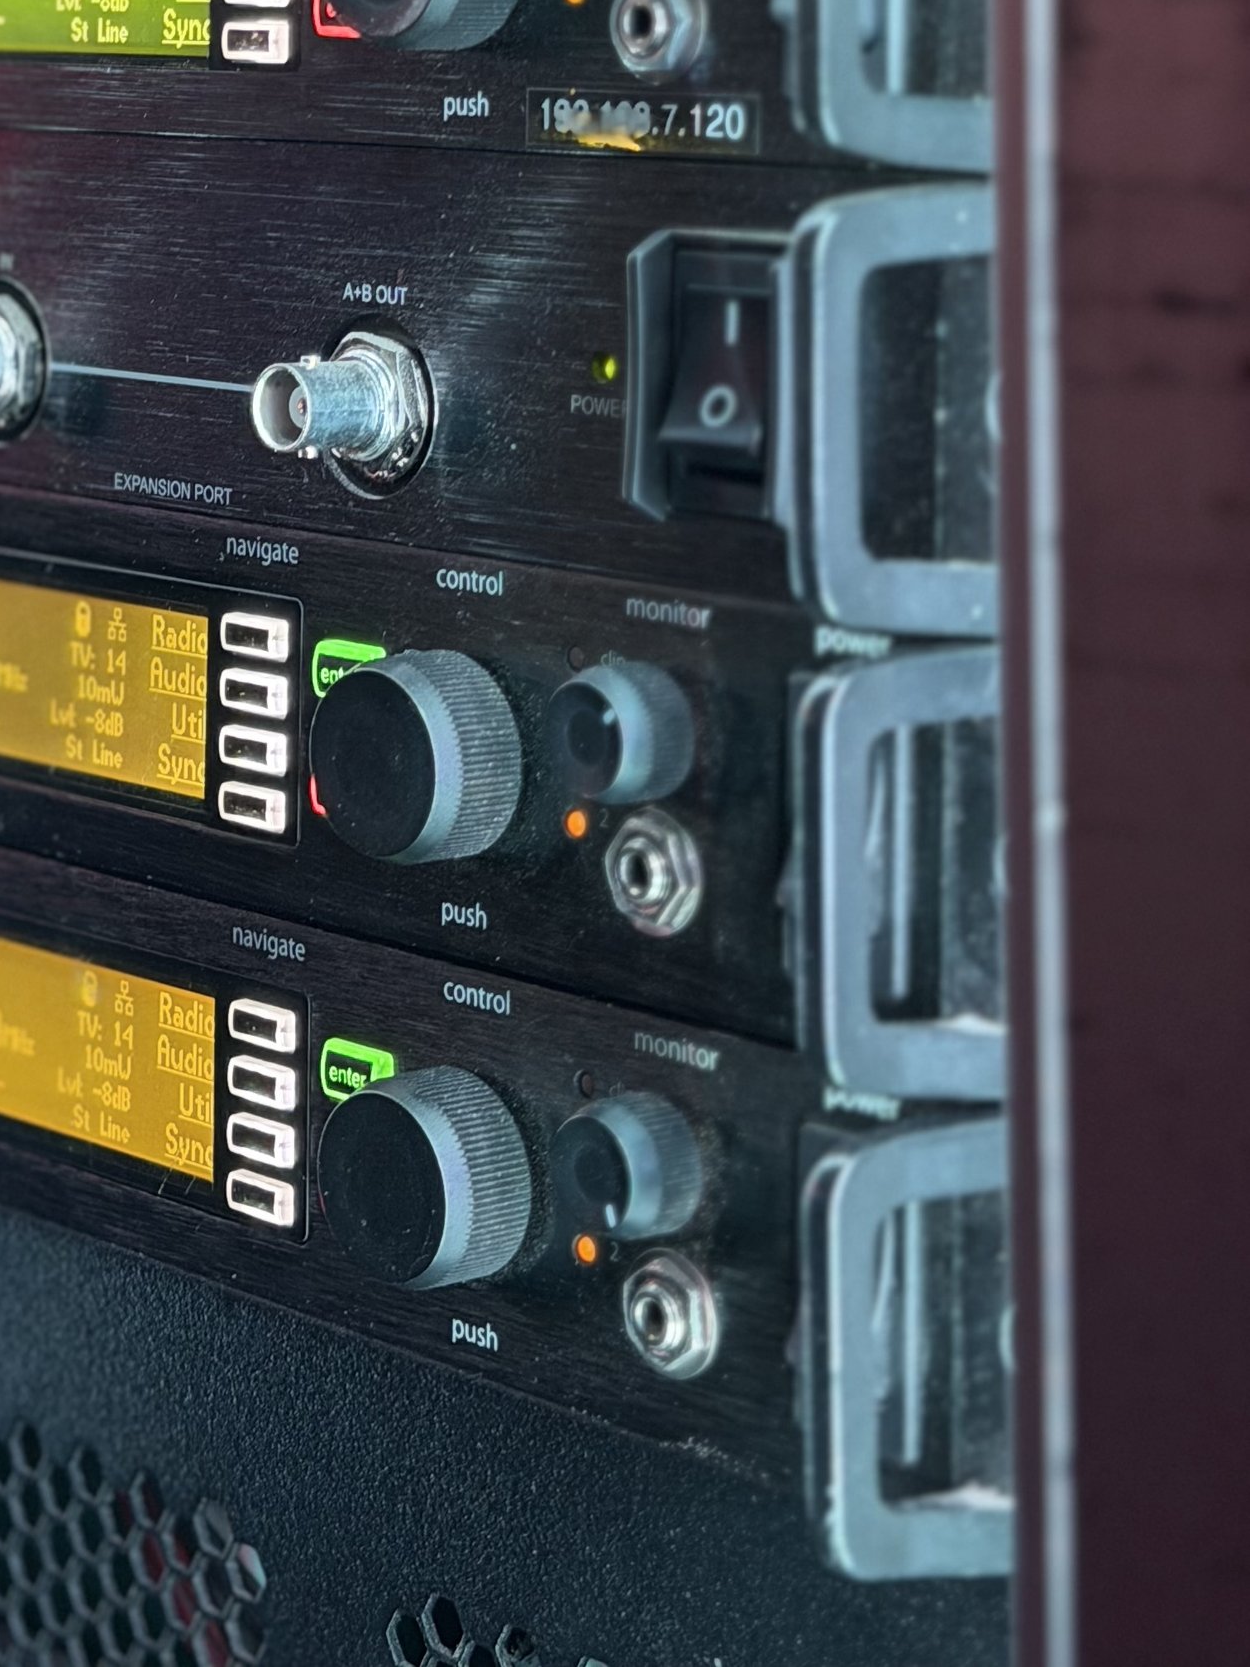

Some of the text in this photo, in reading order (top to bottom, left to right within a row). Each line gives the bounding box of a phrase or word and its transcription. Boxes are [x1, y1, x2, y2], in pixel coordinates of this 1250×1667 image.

[71, 17, 128, 43] St Line
[443, 90, 489, 121] push
[342, 282, 408, 305] A+B OUT
[114, 472, 233, 506] EXPANSION PORT
[226, 534, 300, 565] navigate
[436, 566, 504, 597] control
[626, 595, 711, 629] monitor
[152, 614, 207, 654] Radio
[70, 642, 126, 675] TV: 14
[77, 675, 125, 707] 10mW
[150, 657, 207, 697] Audio
[86, 708, 124, 737] -8dB
[65, 735, 123, 768] St Line
[441, 899, 487, 931] push
[232, 924, 306, 962] navigate
[159, 991, 215, 1036] Radio
[443, 979, 511, 1016] control
[77, 1011, 134, 1050] TV: 14
[85, 1044, 132, 1080] 10mW
[157, 1034, 214, 1080] Audio
[634, 1029, 719, 1071] monitor
[329, 1065, 367, 1089] enter
[93, 1081, 131, 1112] -8dB
[72, 1105, 130, 1144] St Line
[451, 1316, 499, 1352] push
